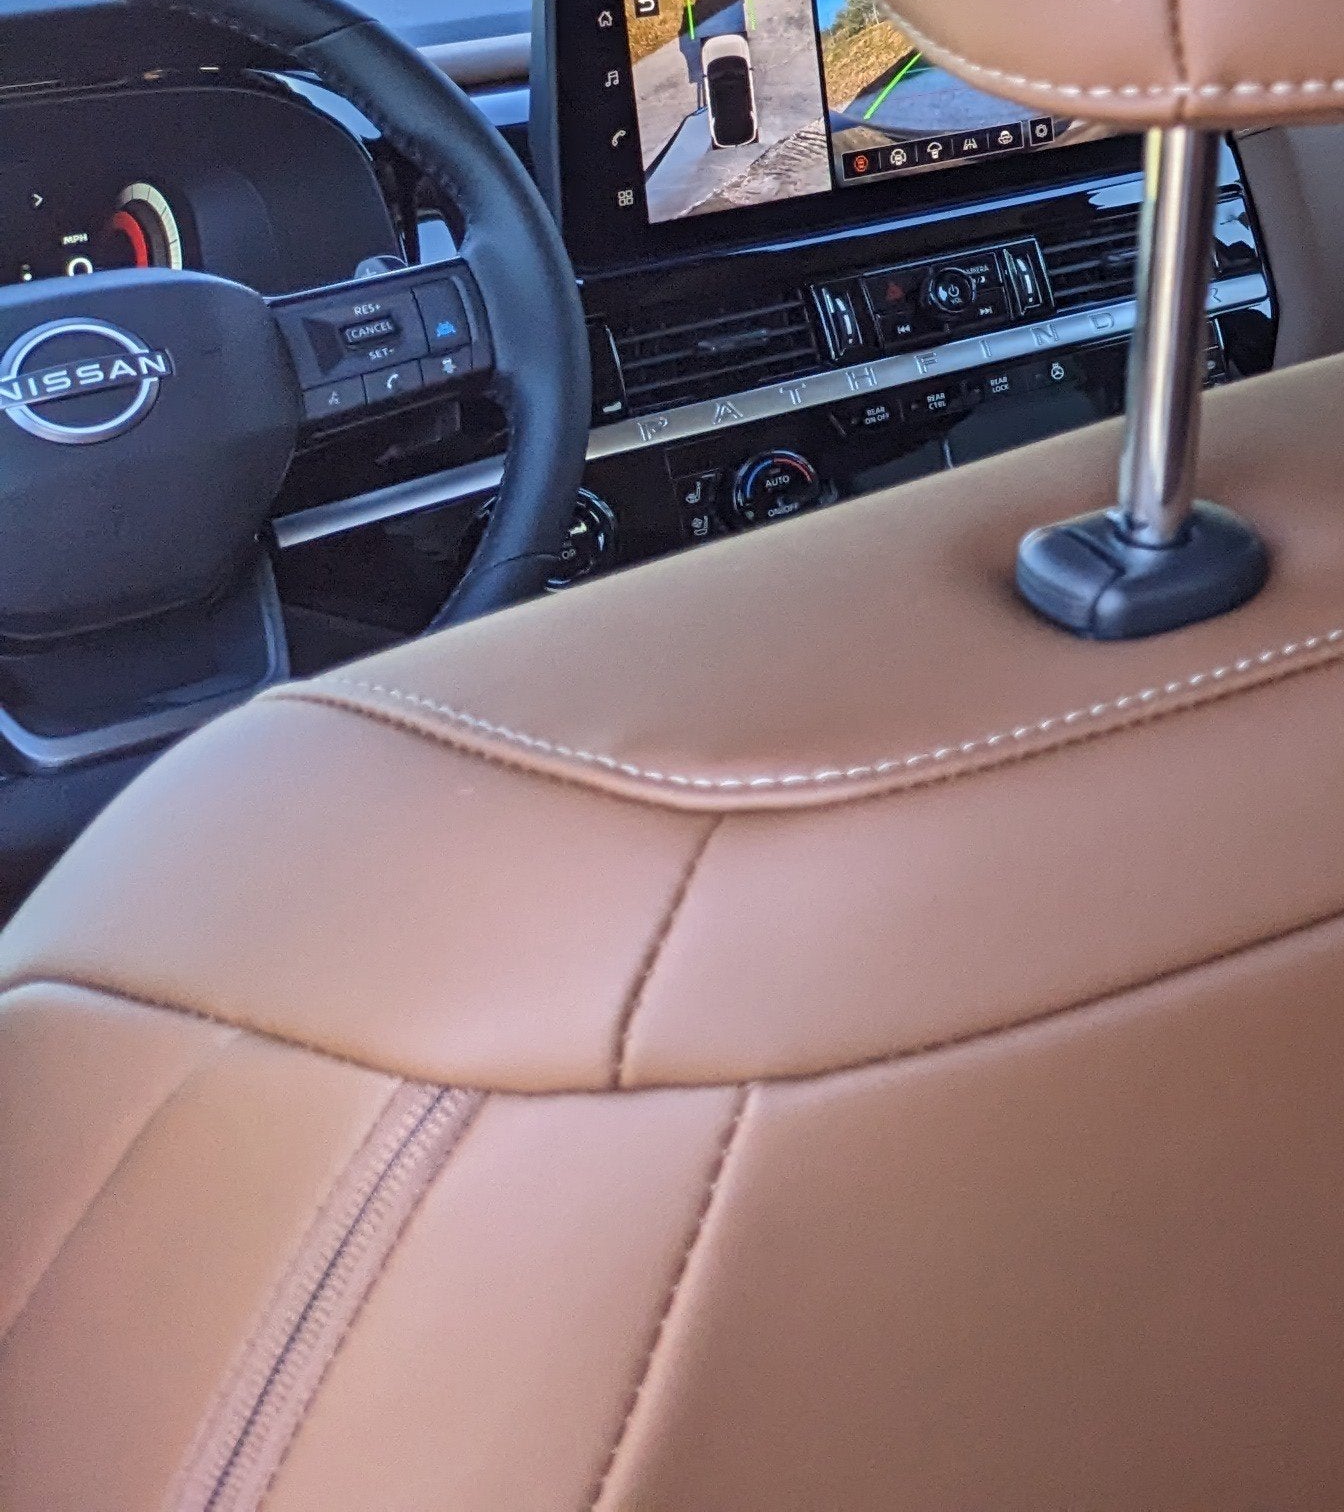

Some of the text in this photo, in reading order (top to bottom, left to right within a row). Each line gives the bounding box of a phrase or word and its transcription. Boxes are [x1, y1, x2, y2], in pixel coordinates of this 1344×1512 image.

[62, 233, 89, 245] MPH
[350, 321, 394, 339] CANCEL
[0, 354, 167, 401] NISSAN
[990, 376, 1008, 386] REAR
[992, 384, 1010, 394] LOCK
[927, 392, 946, 402] REAR
[928, 400, 947, 410] CTRL
[866, 406, 885, 416] REAR
[765, 475, 790, 488] AUTO
